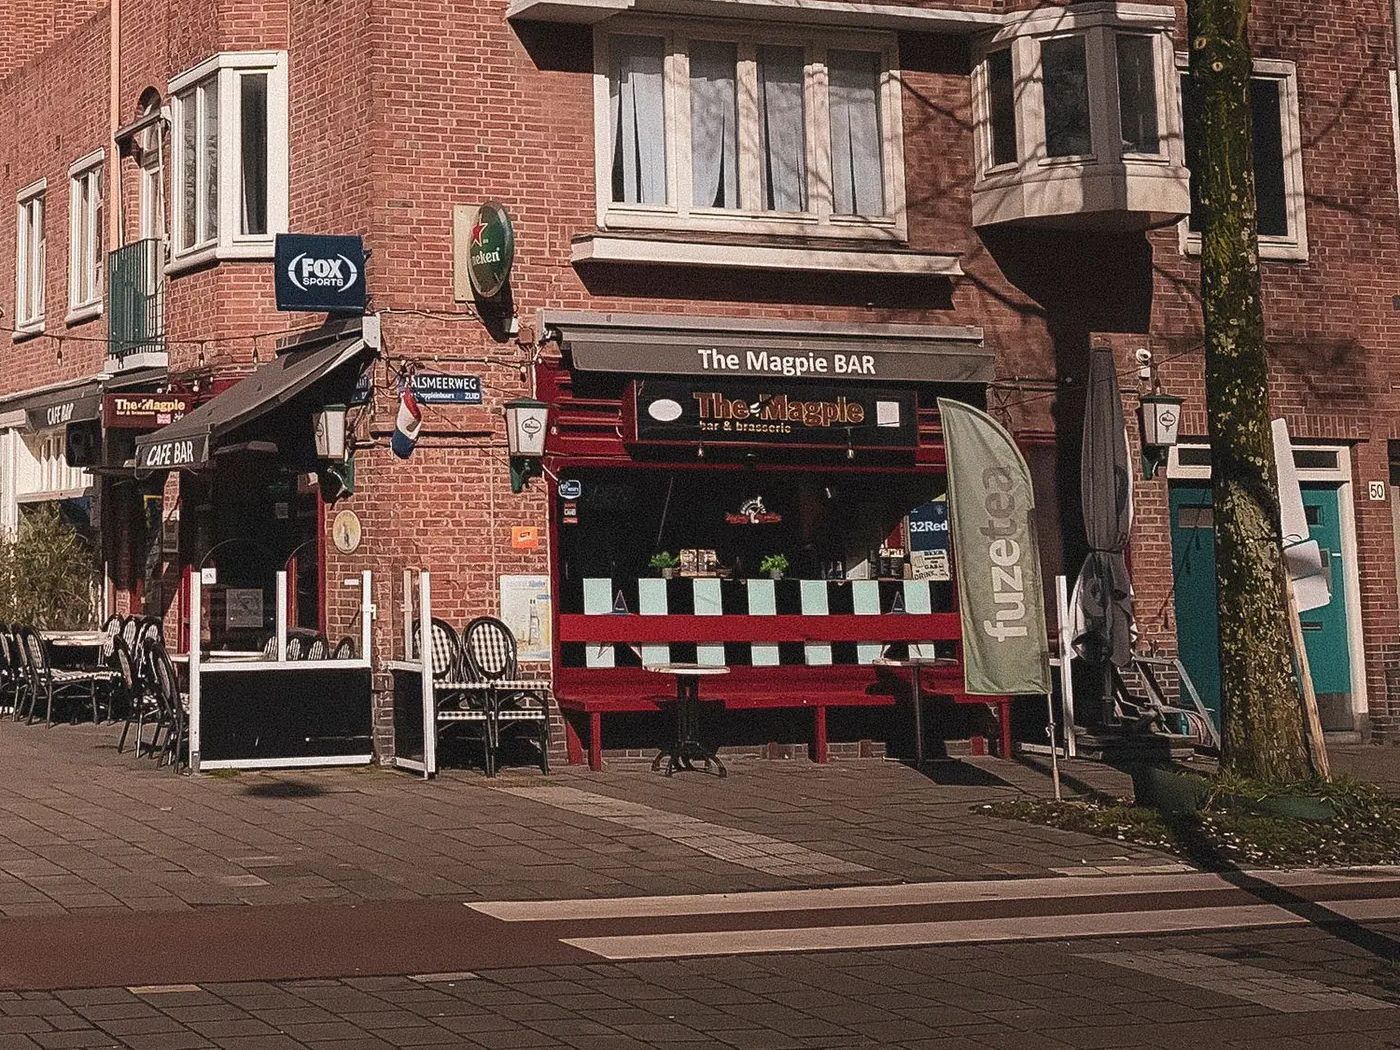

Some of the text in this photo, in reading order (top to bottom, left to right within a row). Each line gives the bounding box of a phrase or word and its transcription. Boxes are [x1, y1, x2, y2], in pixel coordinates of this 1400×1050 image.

[472, 249, 499, 265] neken
[302, 258, 343, 278] FOX
[302, 277, 344, 286] SPORTS
[698, 349, 876, 376] The Magpie BAR
[47, 402, 74, 425] CAFE BAR
[114, 398, 185, 412] The Magpie
[693, 392, 865, 427] The Magpie
[699, 420, 792, 434] bar & brasserie
[147, 440, 194, 466] CAFE BAR
[1370, 483, 1383, 498] 50
[909, 520, 948, 532] 32Red
[979, 466, 1028, 643] fuzetea
